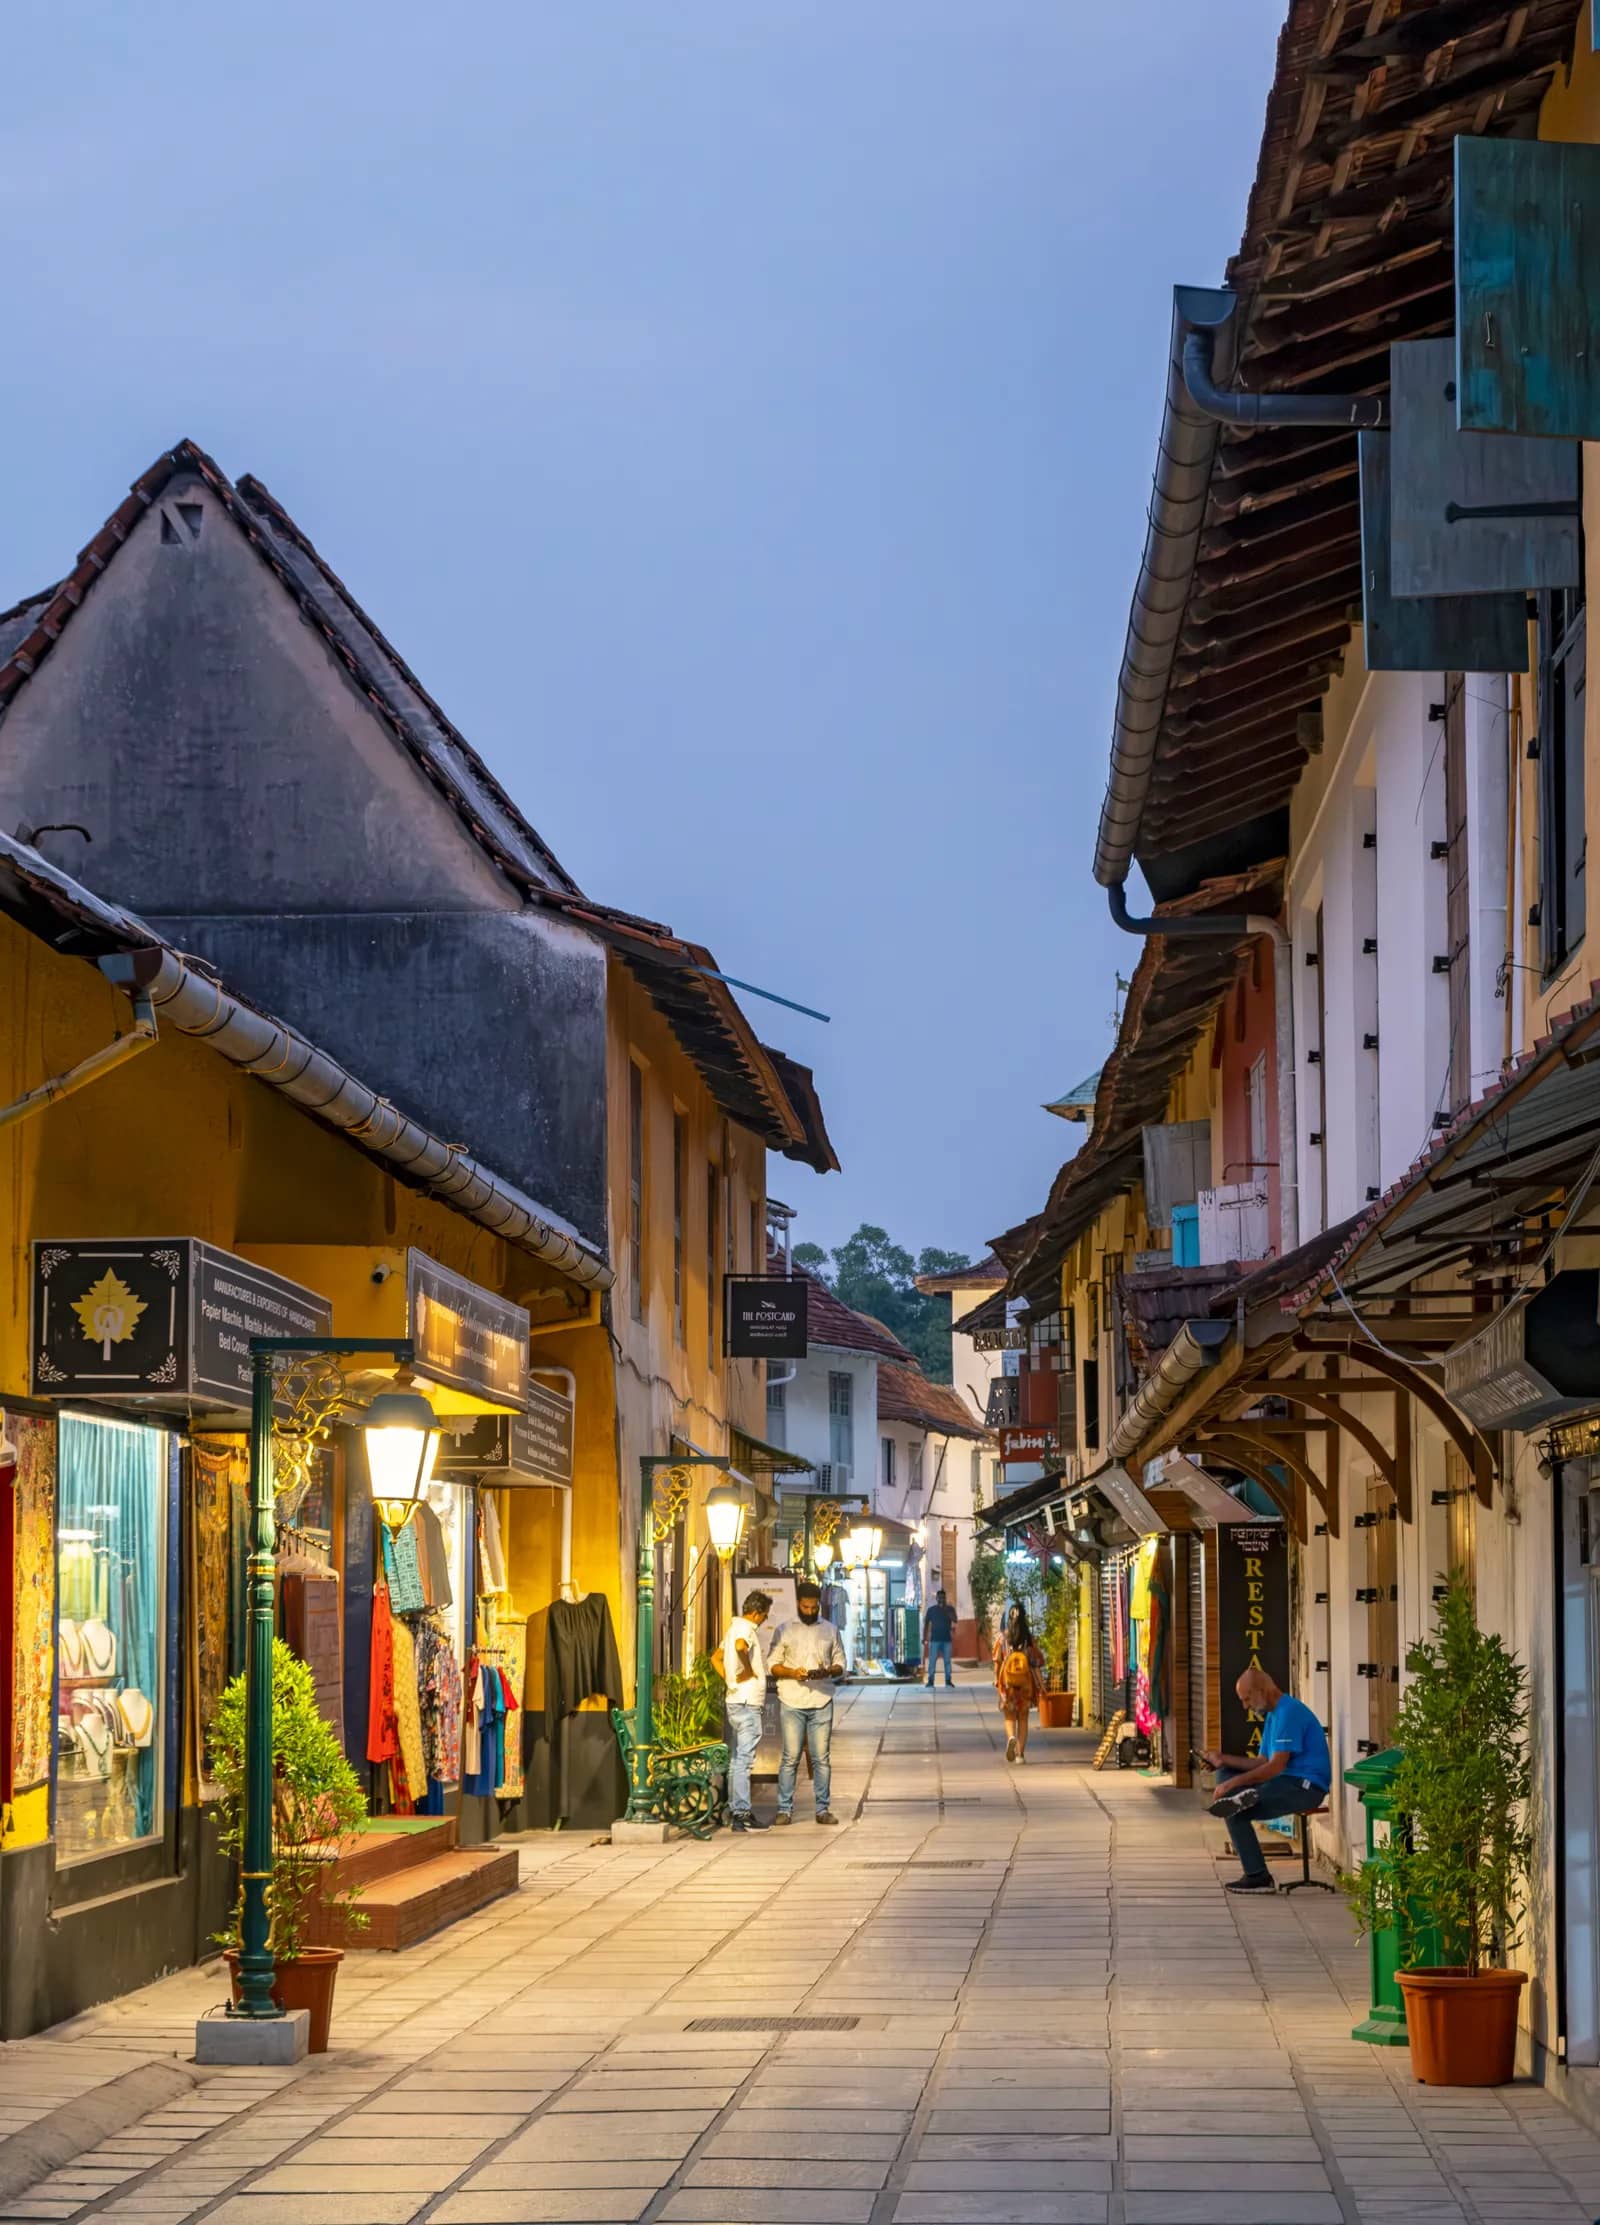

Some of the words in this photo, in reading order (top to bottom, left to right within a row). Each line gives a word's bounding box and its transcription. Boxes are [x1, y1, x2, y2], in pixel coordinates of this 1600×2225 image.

[201, 1299, 221, 1322] Papier
[755, 1312, 795, 1320] POSTCARD
[219, 1332, 230, 1350] Bed
